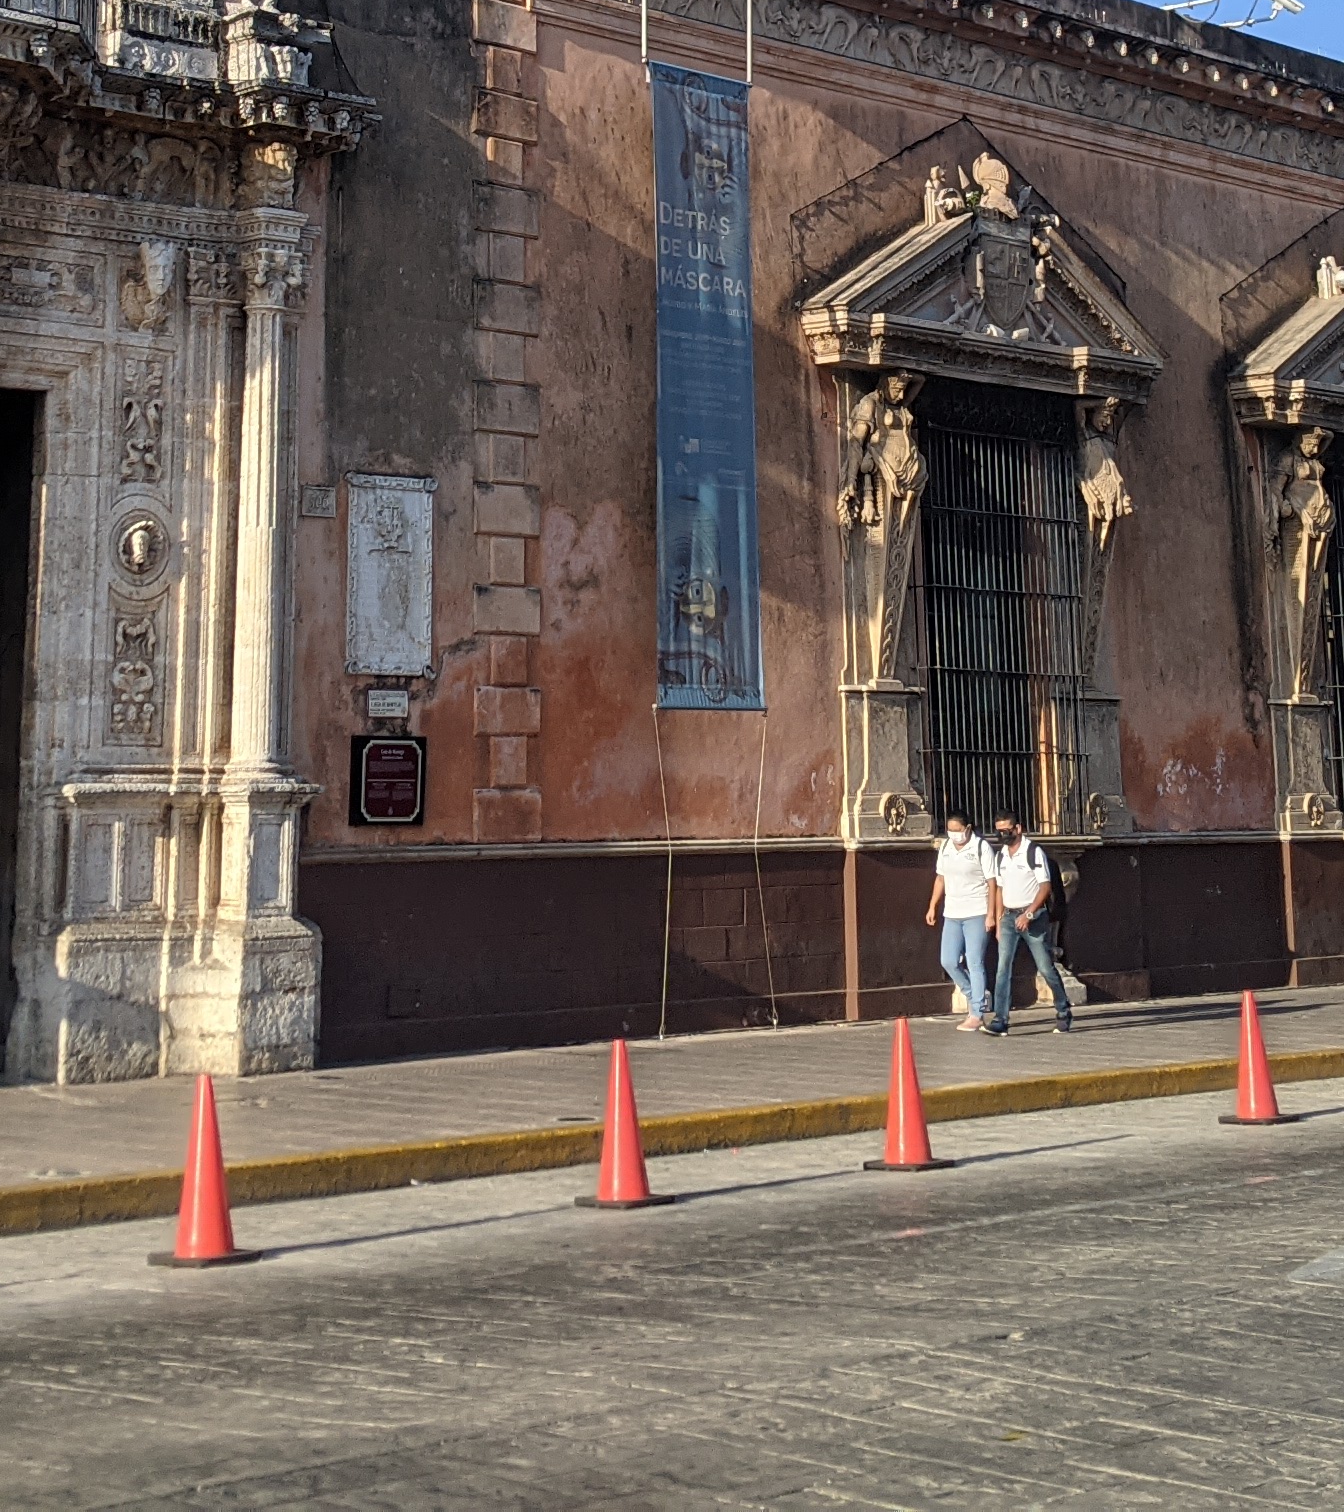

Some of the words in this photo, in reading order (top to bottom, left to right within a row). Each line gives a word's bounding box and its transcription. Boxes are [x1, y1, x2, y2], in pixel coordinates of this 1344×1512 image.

[660, 235, 683, 258] DE
[688, 240, 727, 267] UNA
[660, 264, 748, 299] MÁSCARA
